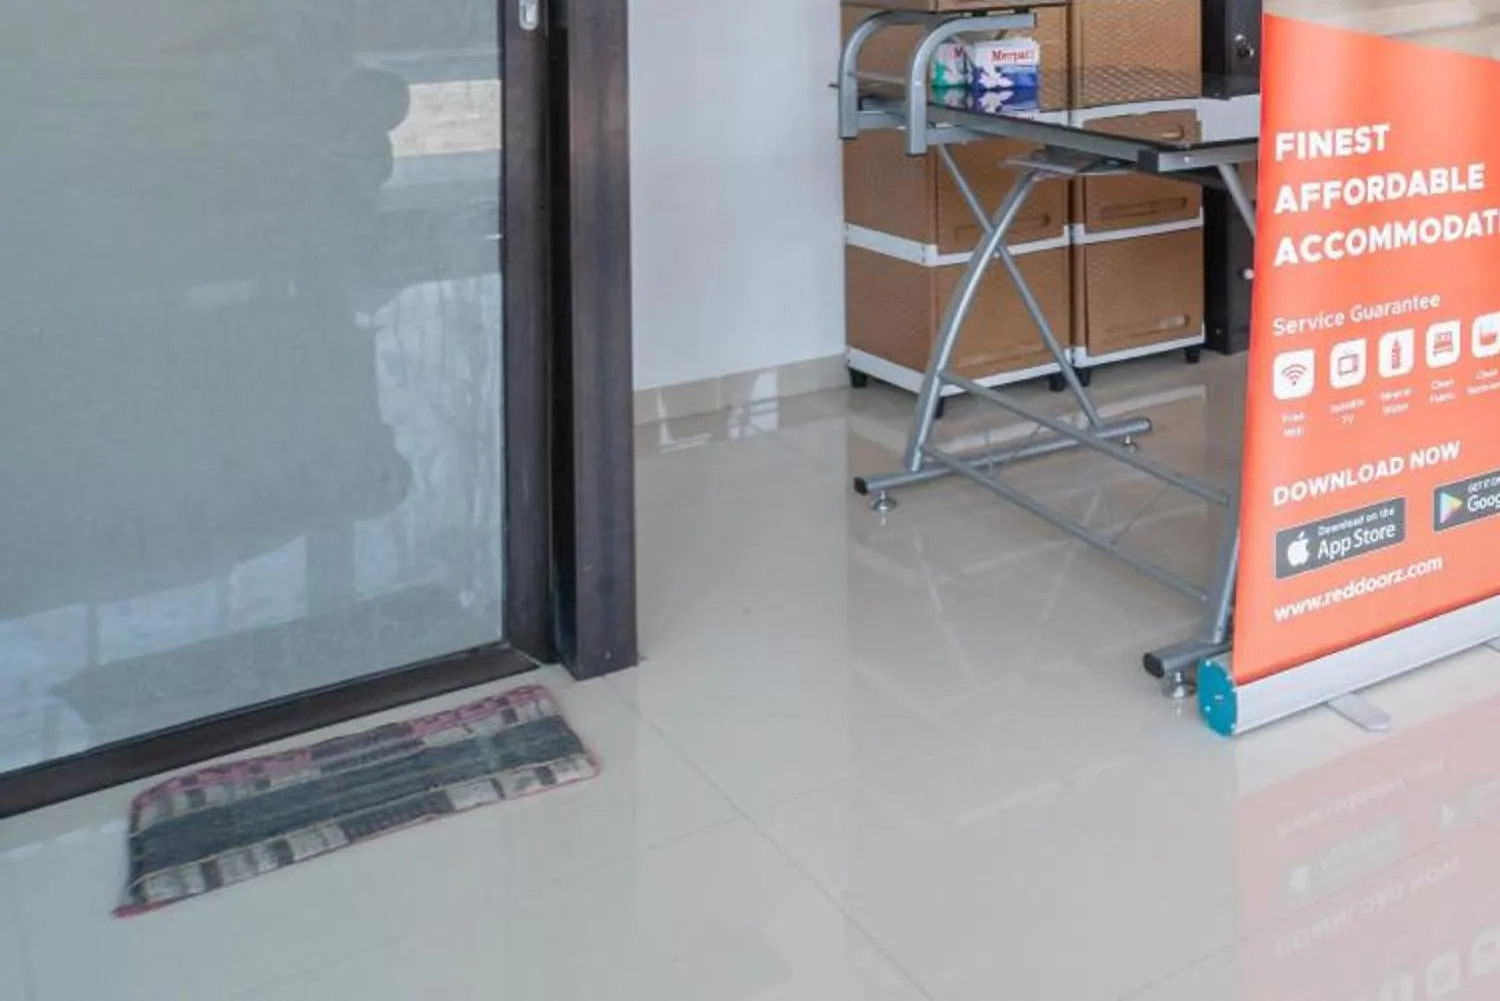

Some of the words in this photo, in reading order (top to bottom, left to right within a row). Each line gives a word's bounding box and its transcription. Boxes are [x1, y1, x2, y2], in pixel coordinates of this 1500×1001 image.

[1275, 123, 1391, 162] FINEST
[1274, 163, 1486, 215] AFFORDABLE
[1273, 310, 1346, 337] Service
[1350, 293, 1442, 324] Guarantee
[1272, 455, 1404, 507] DOWNLOAD
[1409, 440, 1462, 471] NOW
[1317, 514, 1365, 537] Download
[1366, 510, 1379, 523] on
[1317, 532, 1351, 560] App
[1353, 522, 1397, 549] Store
[1274, 555, 1444, 623] www.reddoorz.com
